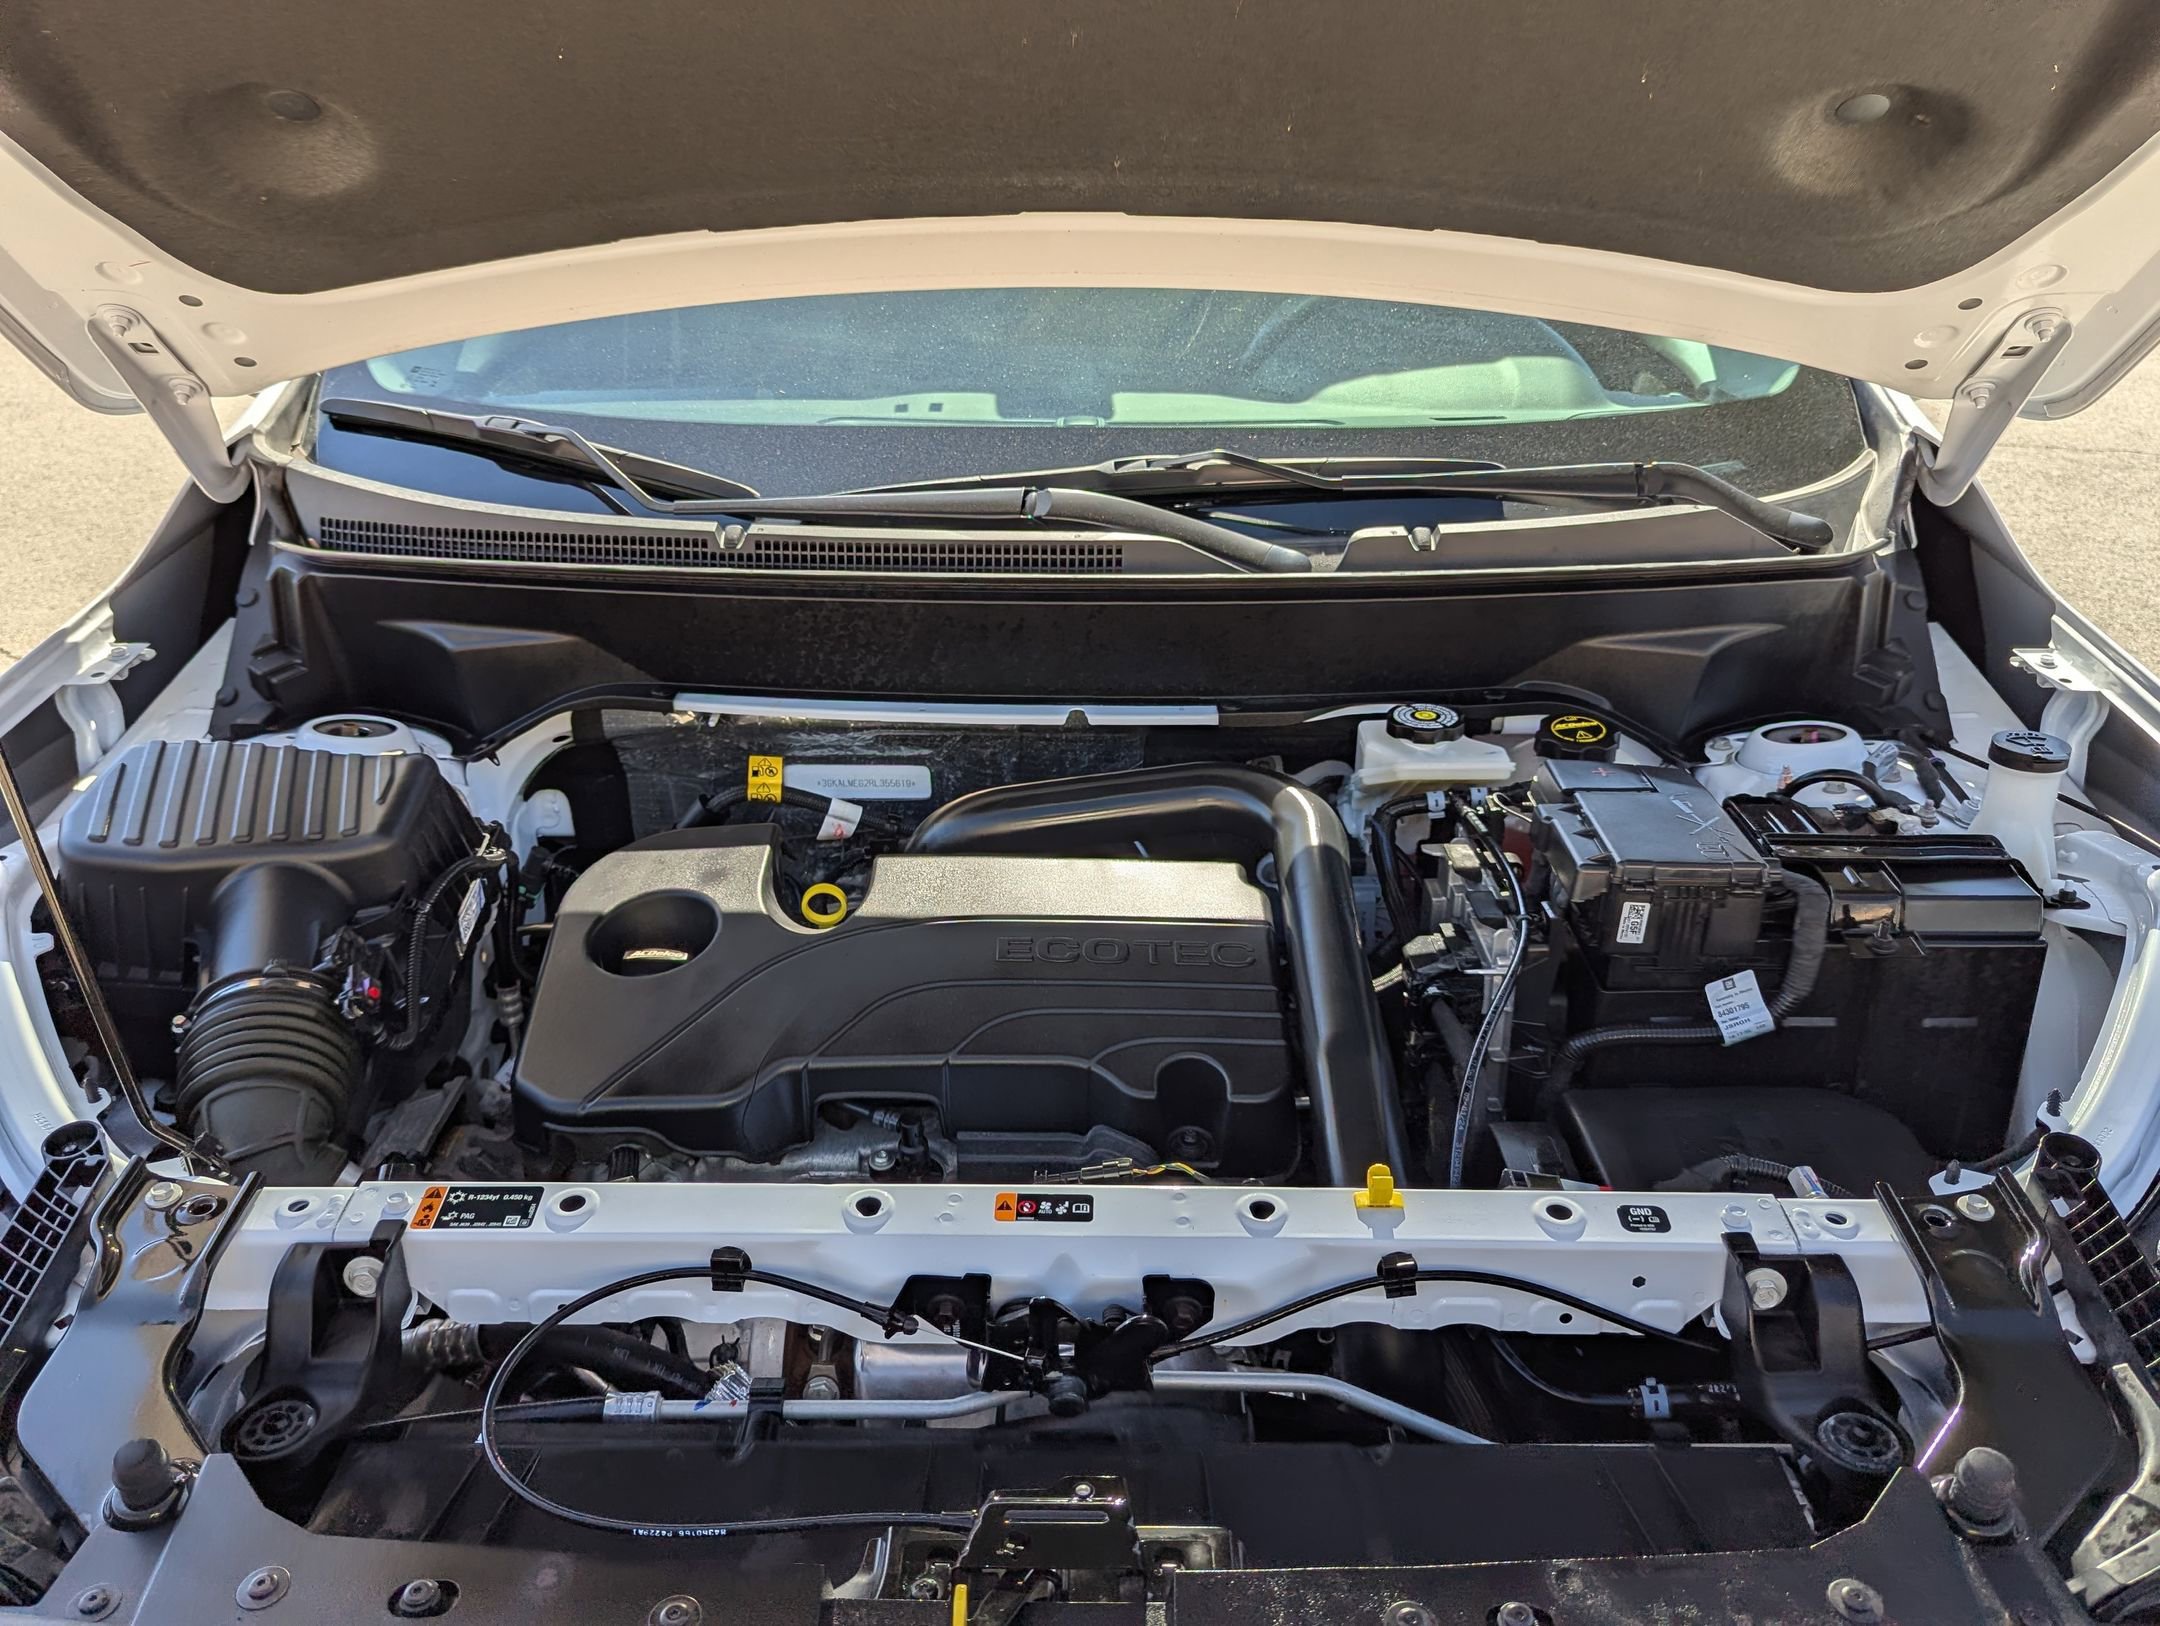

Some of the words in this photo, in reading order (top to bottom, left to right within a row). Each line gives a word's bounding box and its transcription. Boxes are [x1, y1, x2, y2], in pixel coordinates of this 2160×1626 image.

[995, 936, 1257, 968] ECOTEC
[523, 1194, 533, 1202] kg
[1629, 1207, 1652, 1216] GND
[460, 1212, 475, 1220] PAG
